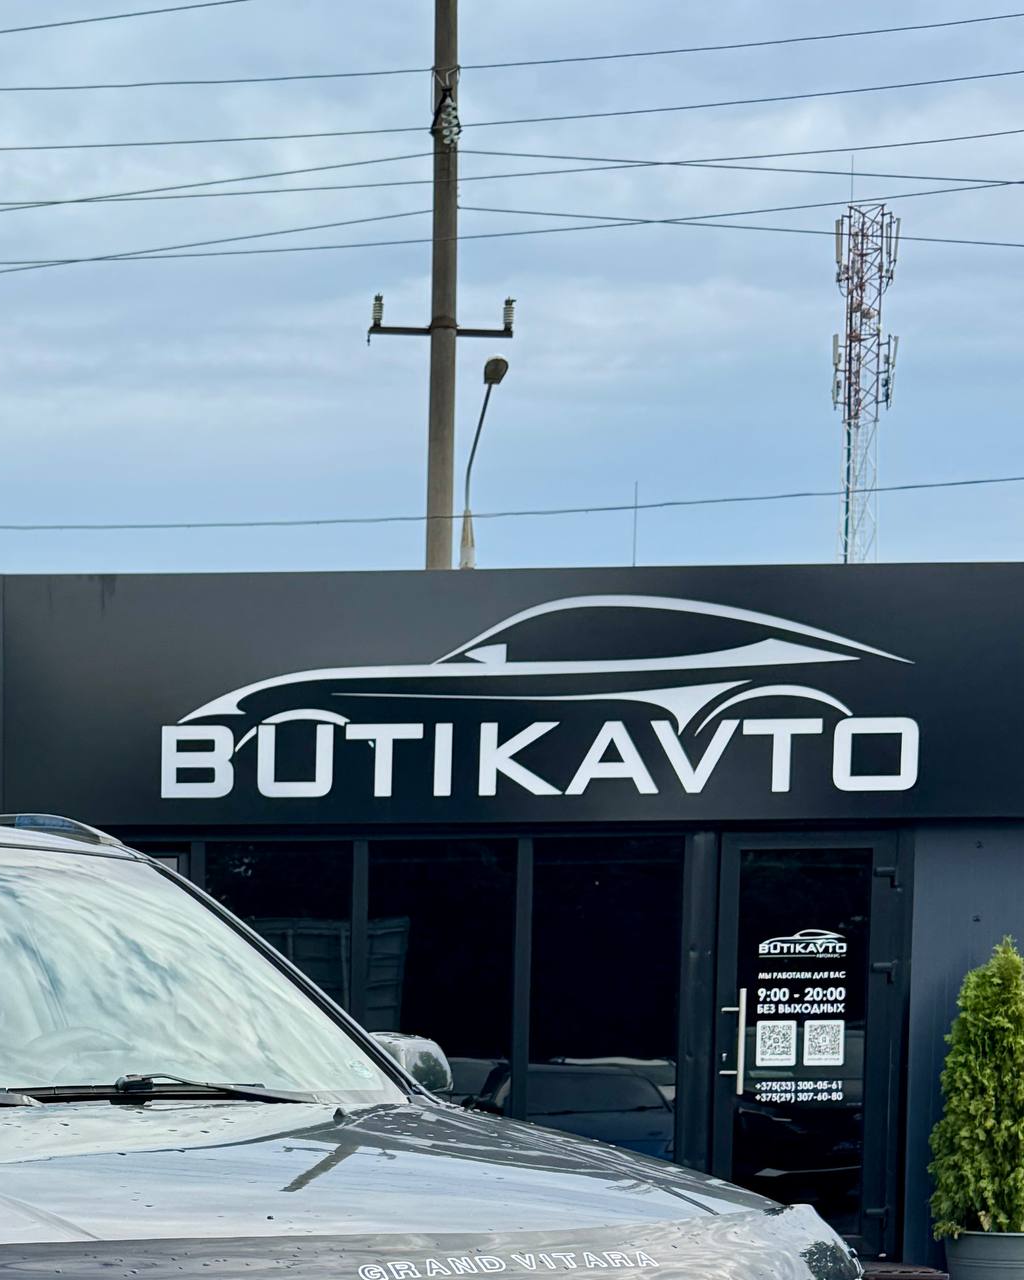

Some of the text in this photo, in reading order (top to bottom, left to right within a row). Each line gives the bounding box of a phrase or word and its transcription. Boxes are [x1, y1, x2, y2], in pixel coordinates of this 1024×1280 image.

[161, 716, 919, 799] BUTIKAVTO
[758, 942, 847, 954] BUTIKAVTO
[758, 970, 846, 980] МЫ РАБОТАЕМ ДЛЯ ВАС
[757, 987, 790, 1002] 9:00
[803, 986, 846, 1001] 20:00
[757, 1002, 845, 1015] БЕЗ ВЫХОДНЫХ
[755, 1080, 843, 1091] +375(33) 300-05-61
[755, 1091, 844, 1103] +375(29) 307-60-80
[511, 1250, 660, 1271] VITARA
